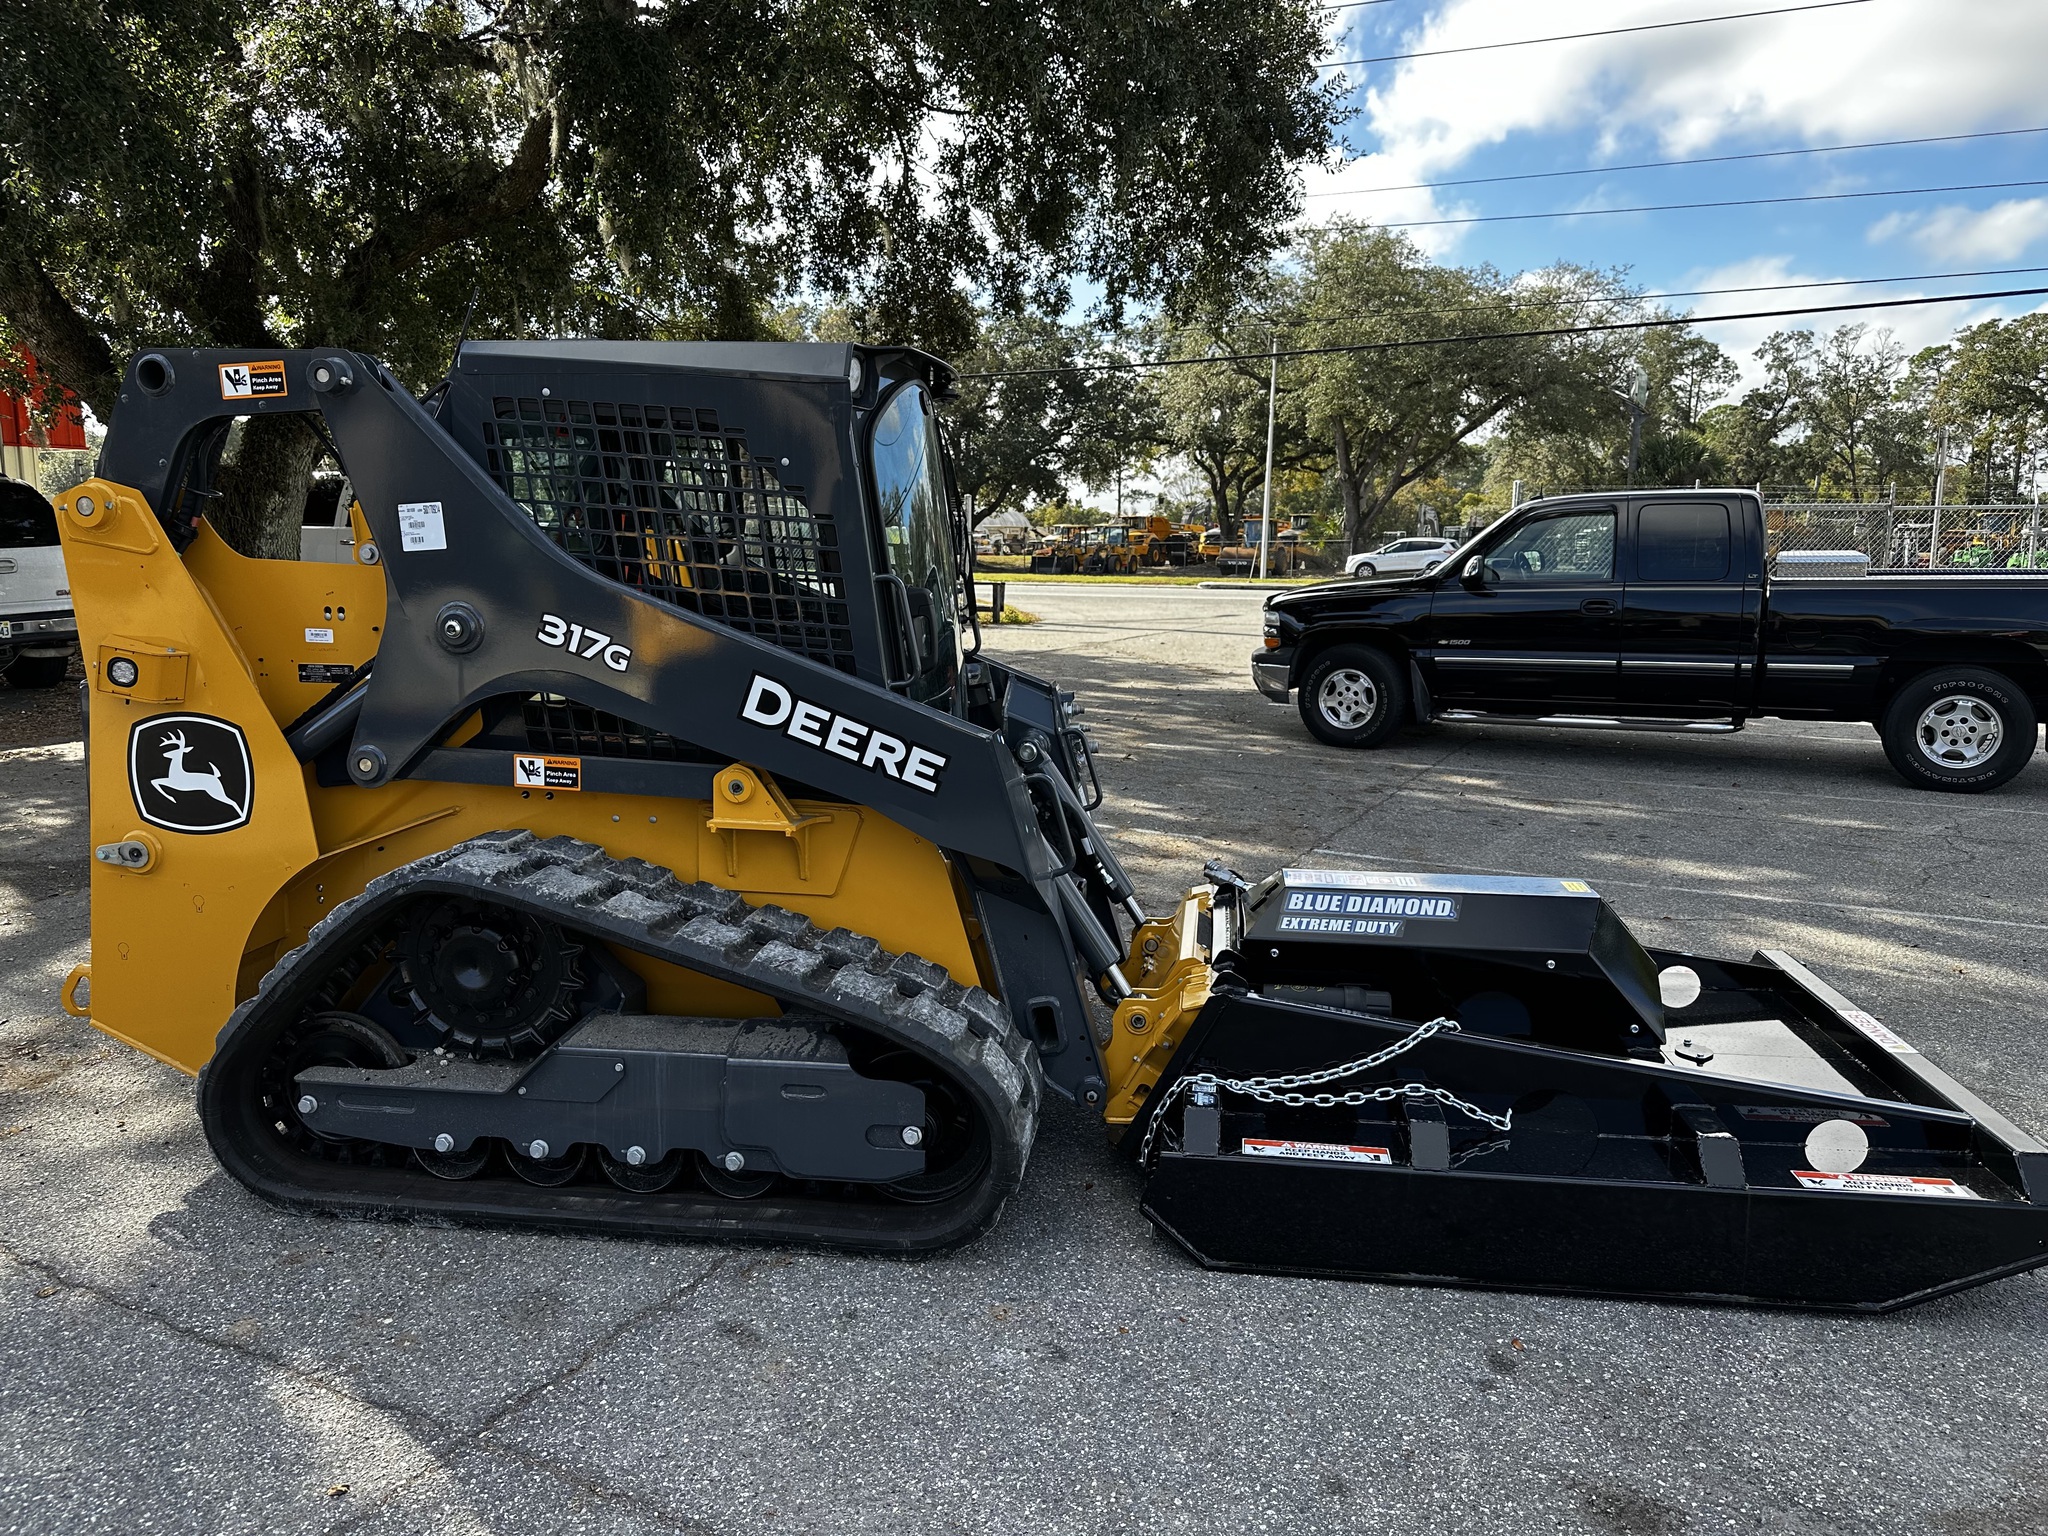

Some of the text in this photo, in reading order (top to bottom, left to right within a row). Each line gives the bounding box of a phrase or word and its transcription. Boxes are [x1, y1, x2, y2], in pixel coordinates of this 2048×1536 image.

[537, 614, 632, 672] 317G
[742, 674, 947, 793] DEERE
[1288, 893, 1343, 912] BLUE
[1280, 917, 1401, 935] EXTREME DUTY
[1294, 1142, 1350, 1151] WARNING
